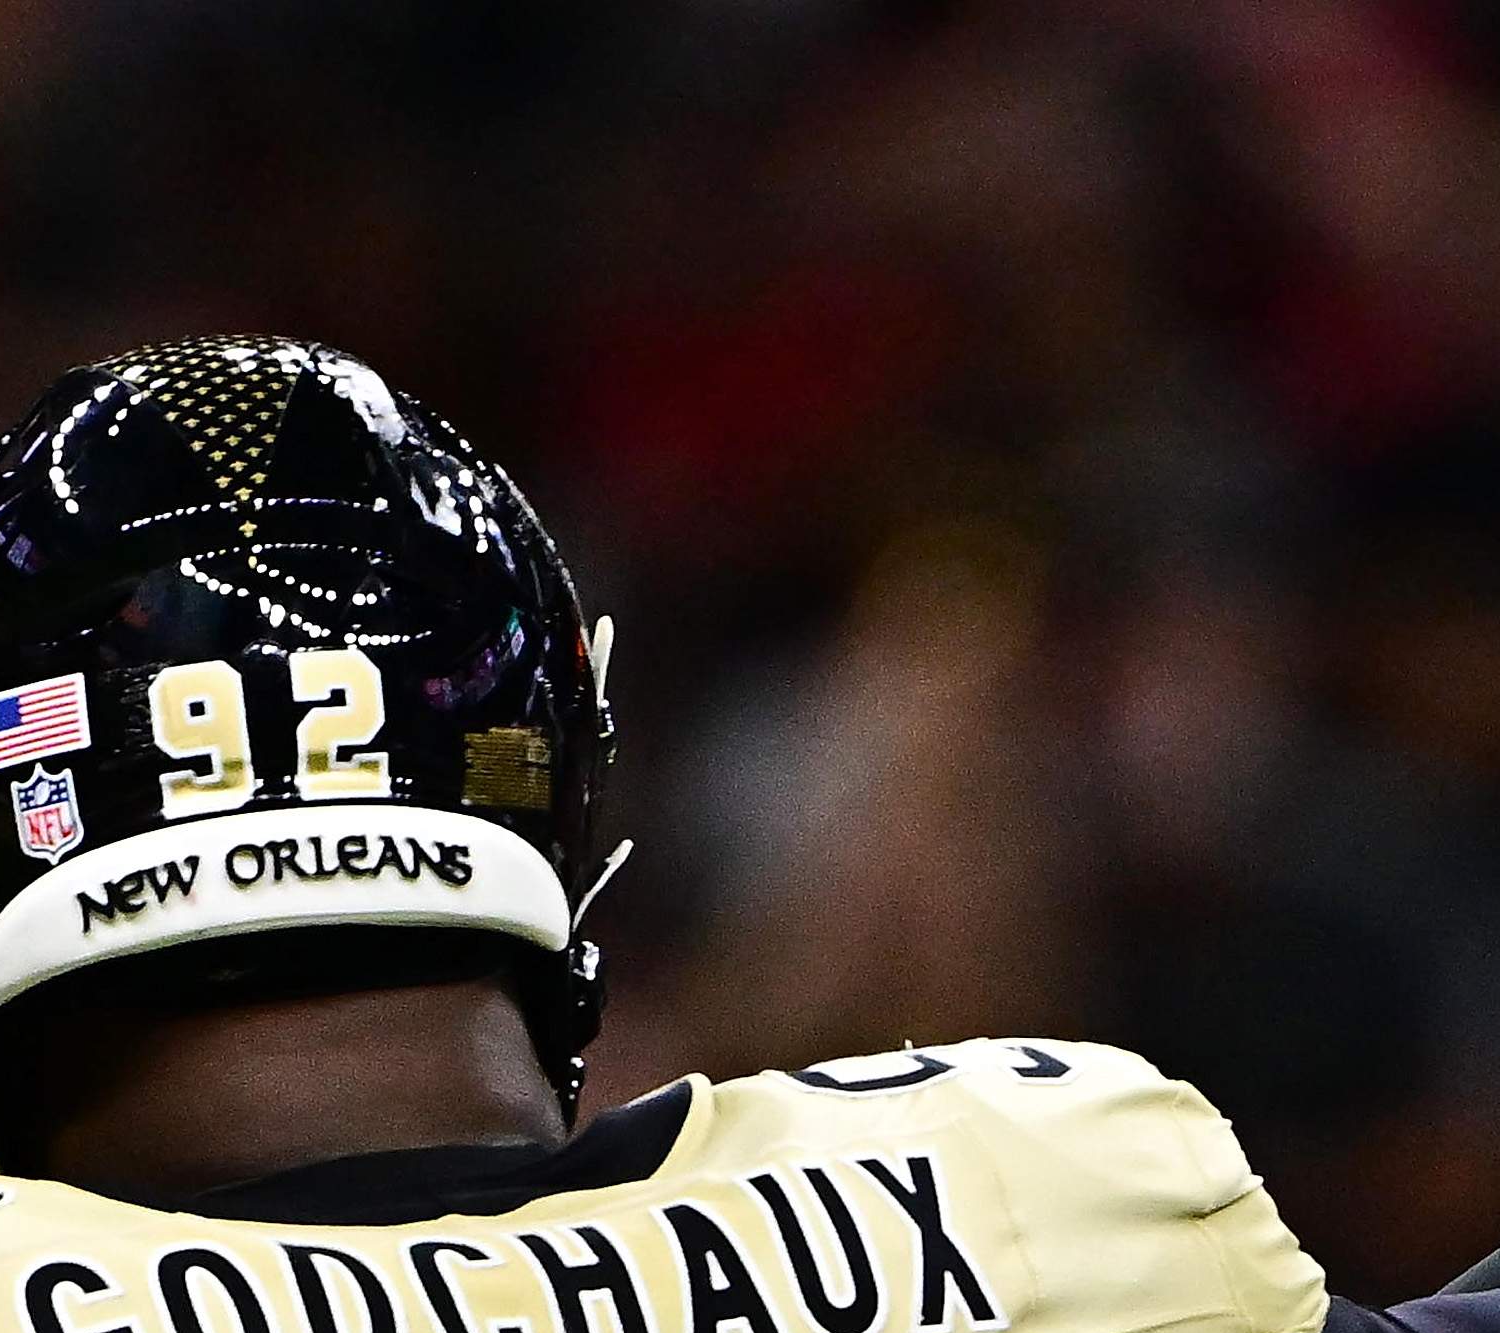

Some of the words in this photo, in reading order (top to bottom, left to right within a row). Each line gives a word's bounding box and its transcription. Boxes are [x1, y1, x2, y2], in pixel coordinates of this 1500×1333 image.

[148, 648, 392, 820] 92
[24, 807, 75, 846] NFL
[76, 853, 201, 935] NEW
[224, 834, 474, 888] ORLEANS
